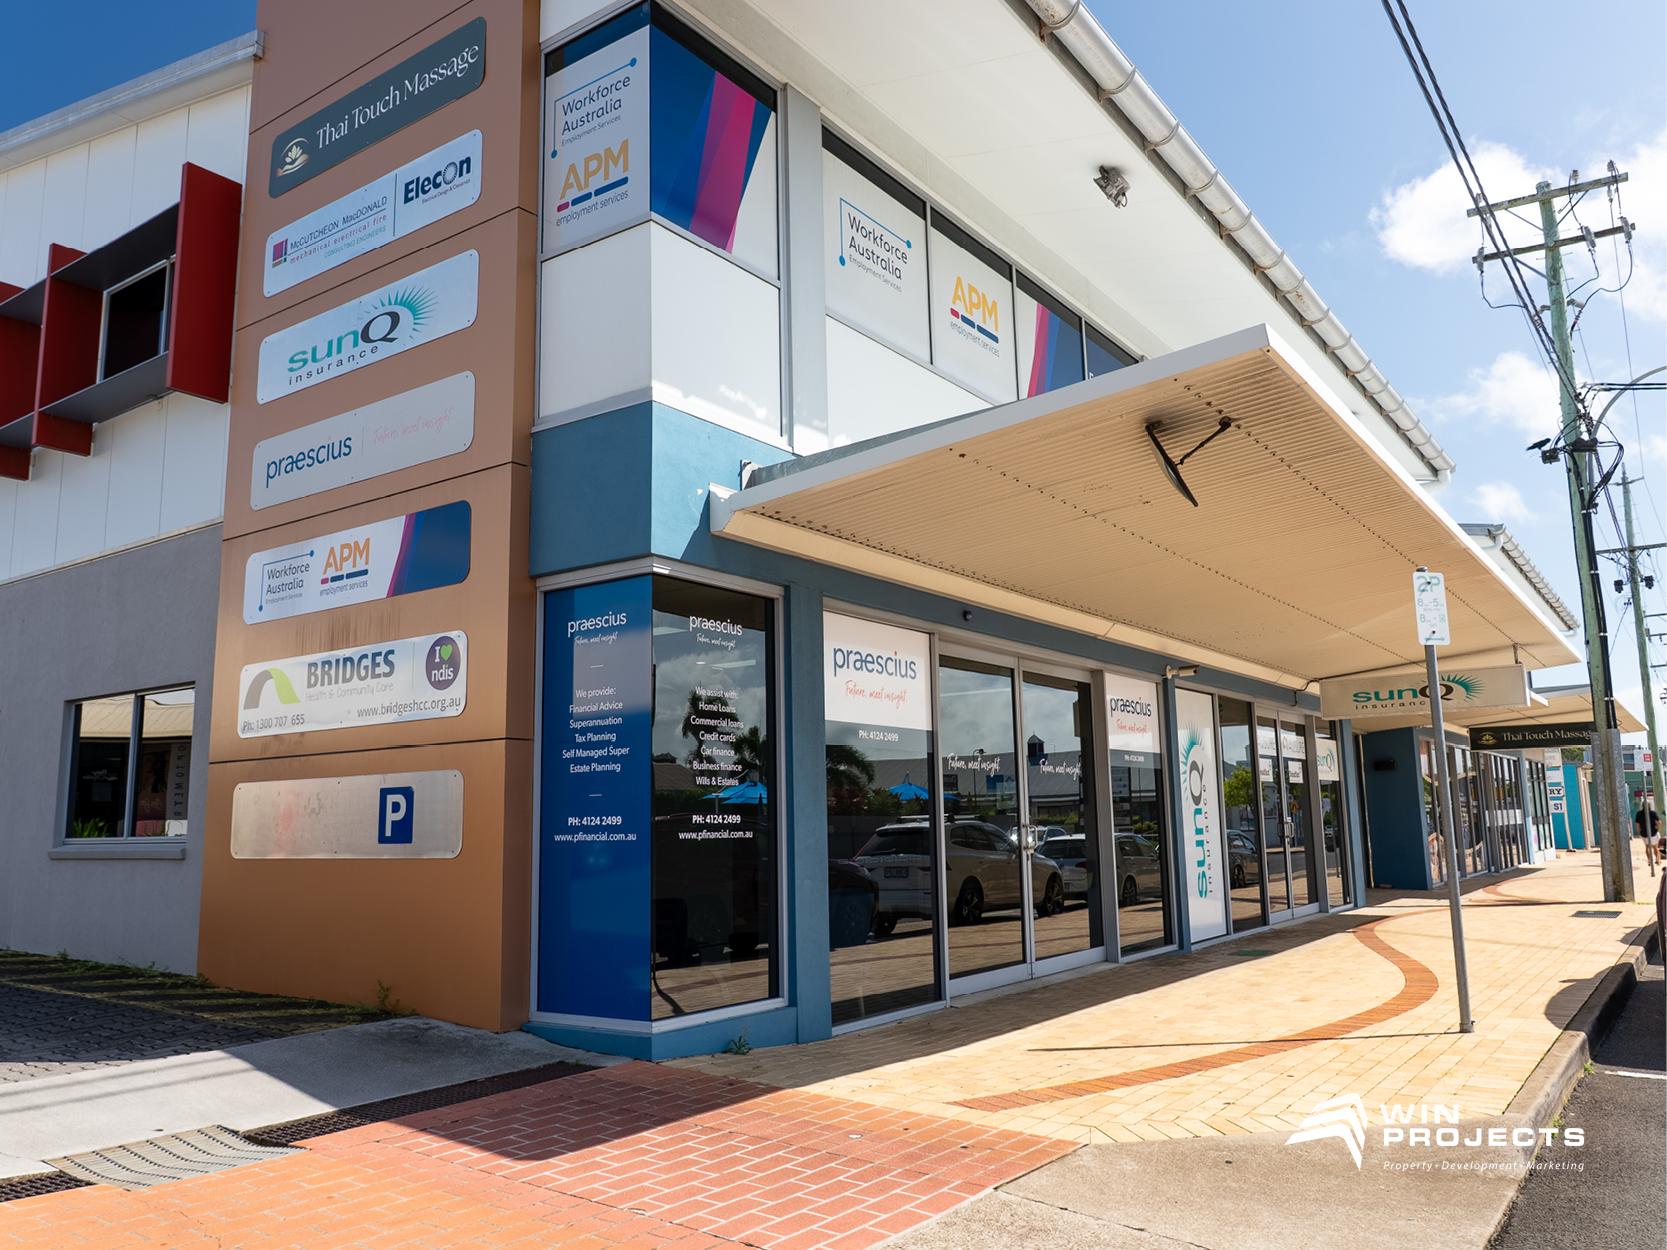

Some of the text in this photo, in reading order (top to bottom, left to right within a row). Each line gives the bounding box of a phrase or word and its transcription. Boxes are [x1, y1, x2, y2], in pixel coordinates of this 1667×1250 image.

[316, 45, 479, 149] Thai Touch Massage
[562, 75, 631, 117] Workforce
[561, 97, 622, 136] Australia
[560, 138, 629, 200] APM
[556, 189, 629, 227] employment services
[290, 196, 388, 249] McCUTCHEON MacDONALD
[848, 212, 908, 264] Workforce
[849, 236, 902, 280] Australia
[952, 275, 999, 332] APM
[287, 310, 400, 373] sunQ
[288, 345, 378, 386] insurance
[266, 436, 352, 488] praescius
[322, 537, 371, 576] APM
[267, 562, 310, 580] Workforce
[266, 577, 304, 596] Australia
[568, 611, 627, 637] praescius
[689, 615, 743, 636] praescius
[306, 649, 395, 689] BRIDGES
[833, 647, 917, 680] praescius
[431, 666, 454, 682] ndis
[576, 686, 616, 699] We provide:
[1352, 683, 1454, 703] sunQ
[357, 696, 461, 718] www.bridgeshcc.org.au
[569, 700, 623, 713] Financial Advice
[699, 702, 737, 713] Home Loans
[1110, 697, 1152, 717] praescius
[1355, 700, 1426, 710] insuranc
[256, 717, 273, 730] 1300
[274, 715, 288, 728] 707
[291, 713, 305, 727] 655
[569, 716, 623, 729] Superannuation
[690, 716, 744, 729] Commercial loans
[575, 731, 617, 744] Tax Planning
[699, 731, 736, 743] Credit cards
[858, 730, 898, 742] PH: 4124 2499
[1502, 729, 1593, 742] Thai Touch Massag
[562, 746, 630, 759] Self Managed Super
[701, 745, 735, 757] Car finance
[570, 762, 621, 774] Estate Planning
[692, 760, 742, 772] Business finance
[696, 776, 739, 786] Wills & Estates
[385, 794, 407, 837] P
[568, 816, 622, 826] PH: 4124 2499
[692, 815, 741, 824] PH: 4124 2499
[554, 830, 637, 843] www.pfinancial.com.au
[678, 829, 753, 841] www.pfinancial.com.au
[1188, 760, 1208, 898] sunQ
[1202, 784, 1213, 894] insurance
